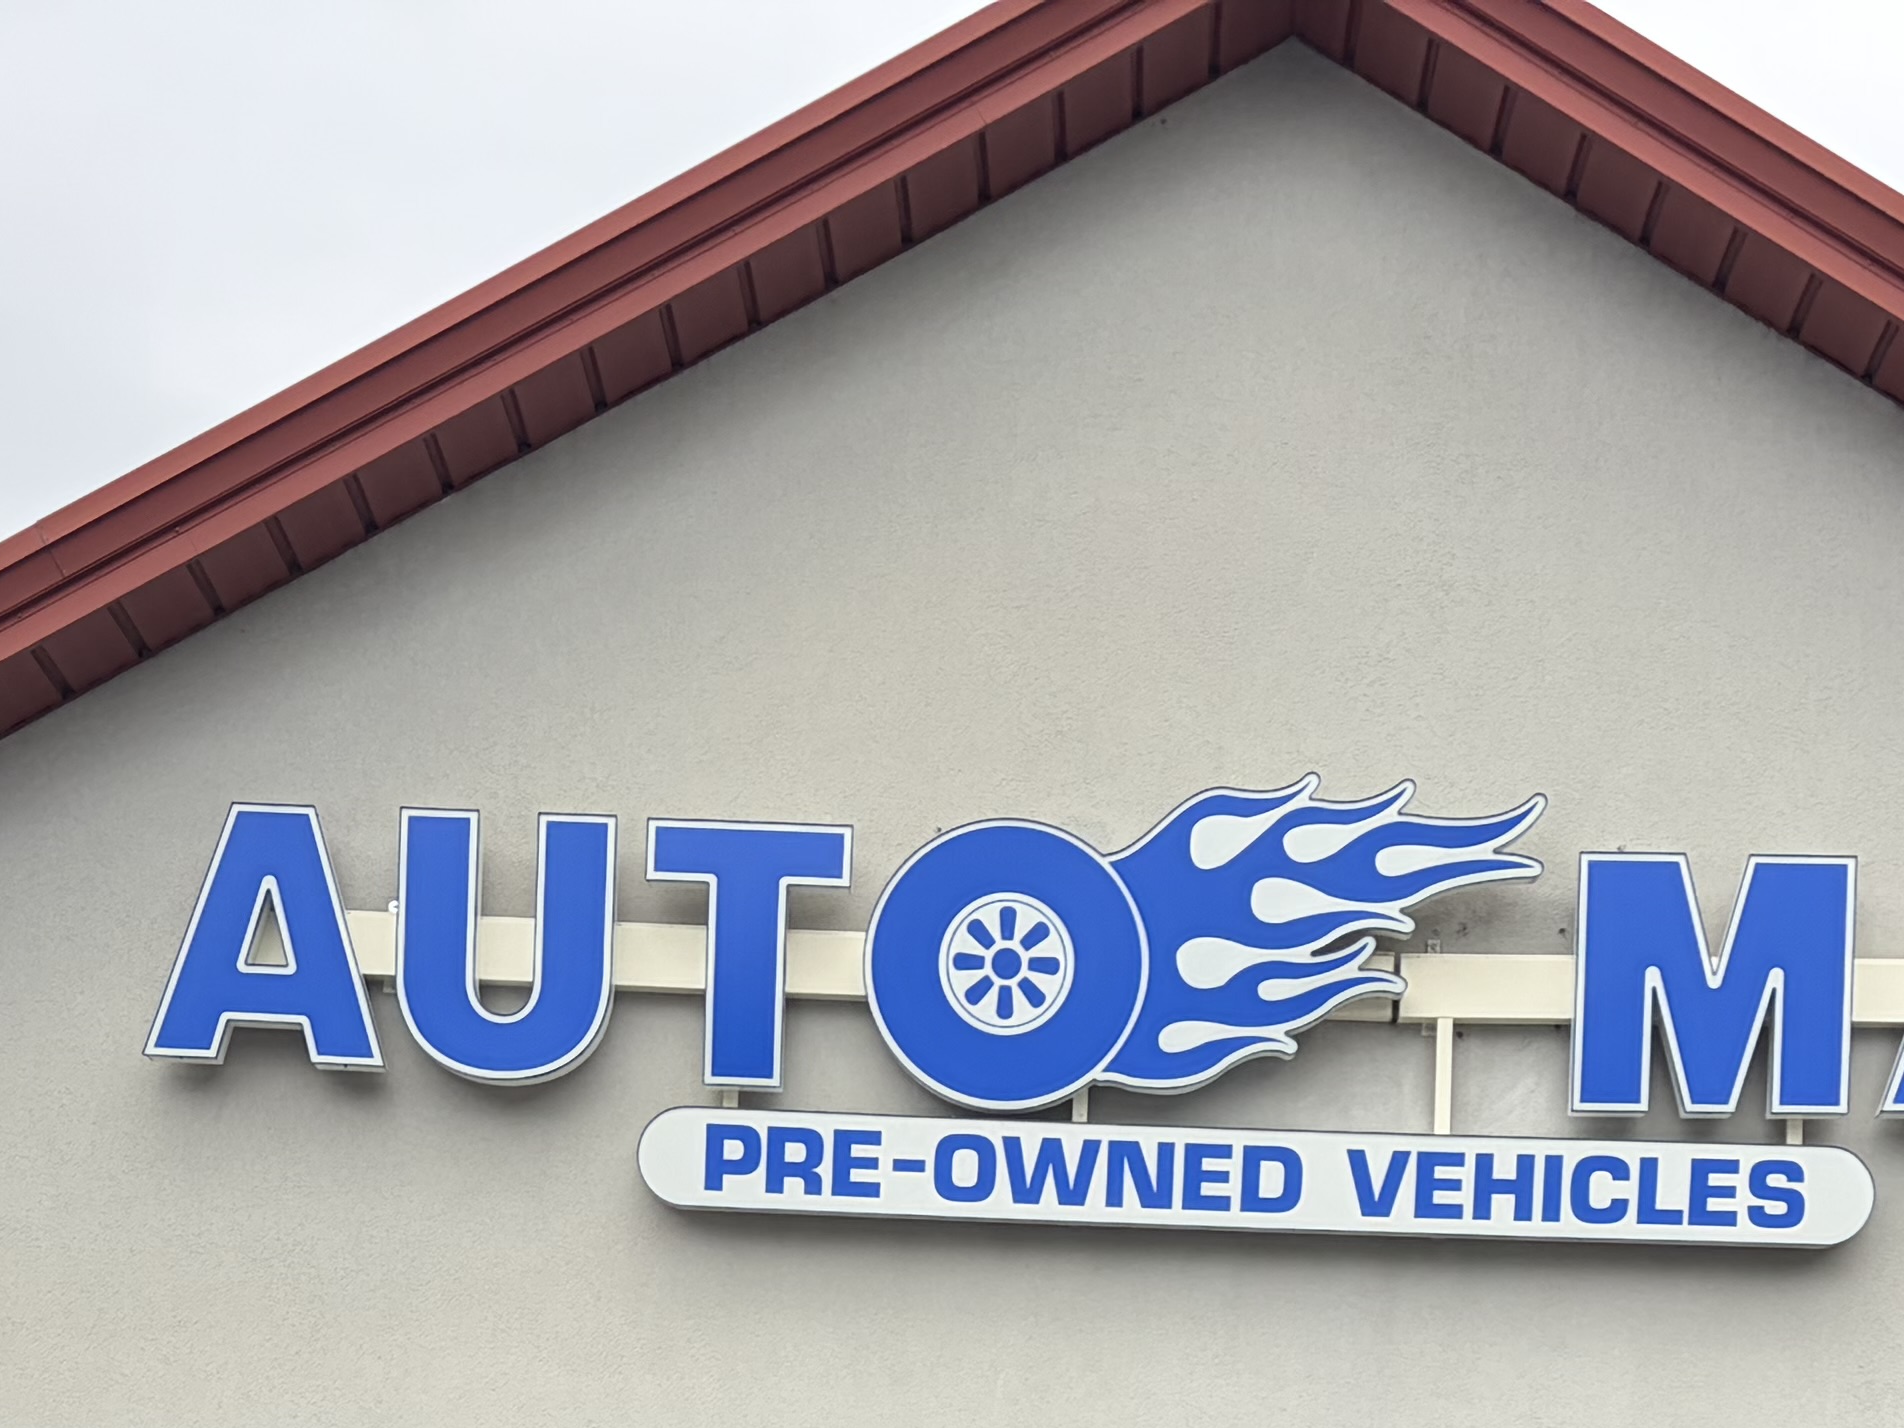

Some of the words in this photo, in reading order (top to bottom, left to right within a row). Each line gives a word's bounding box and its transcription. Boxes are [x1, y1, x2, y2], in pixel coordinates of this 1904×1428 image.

[148, 802, 1149, 1108] AUTO
[702, 1122, 1304, 1214] PRE-OWNED
[1347, 1148, 1806, 1230] VEHICLES
